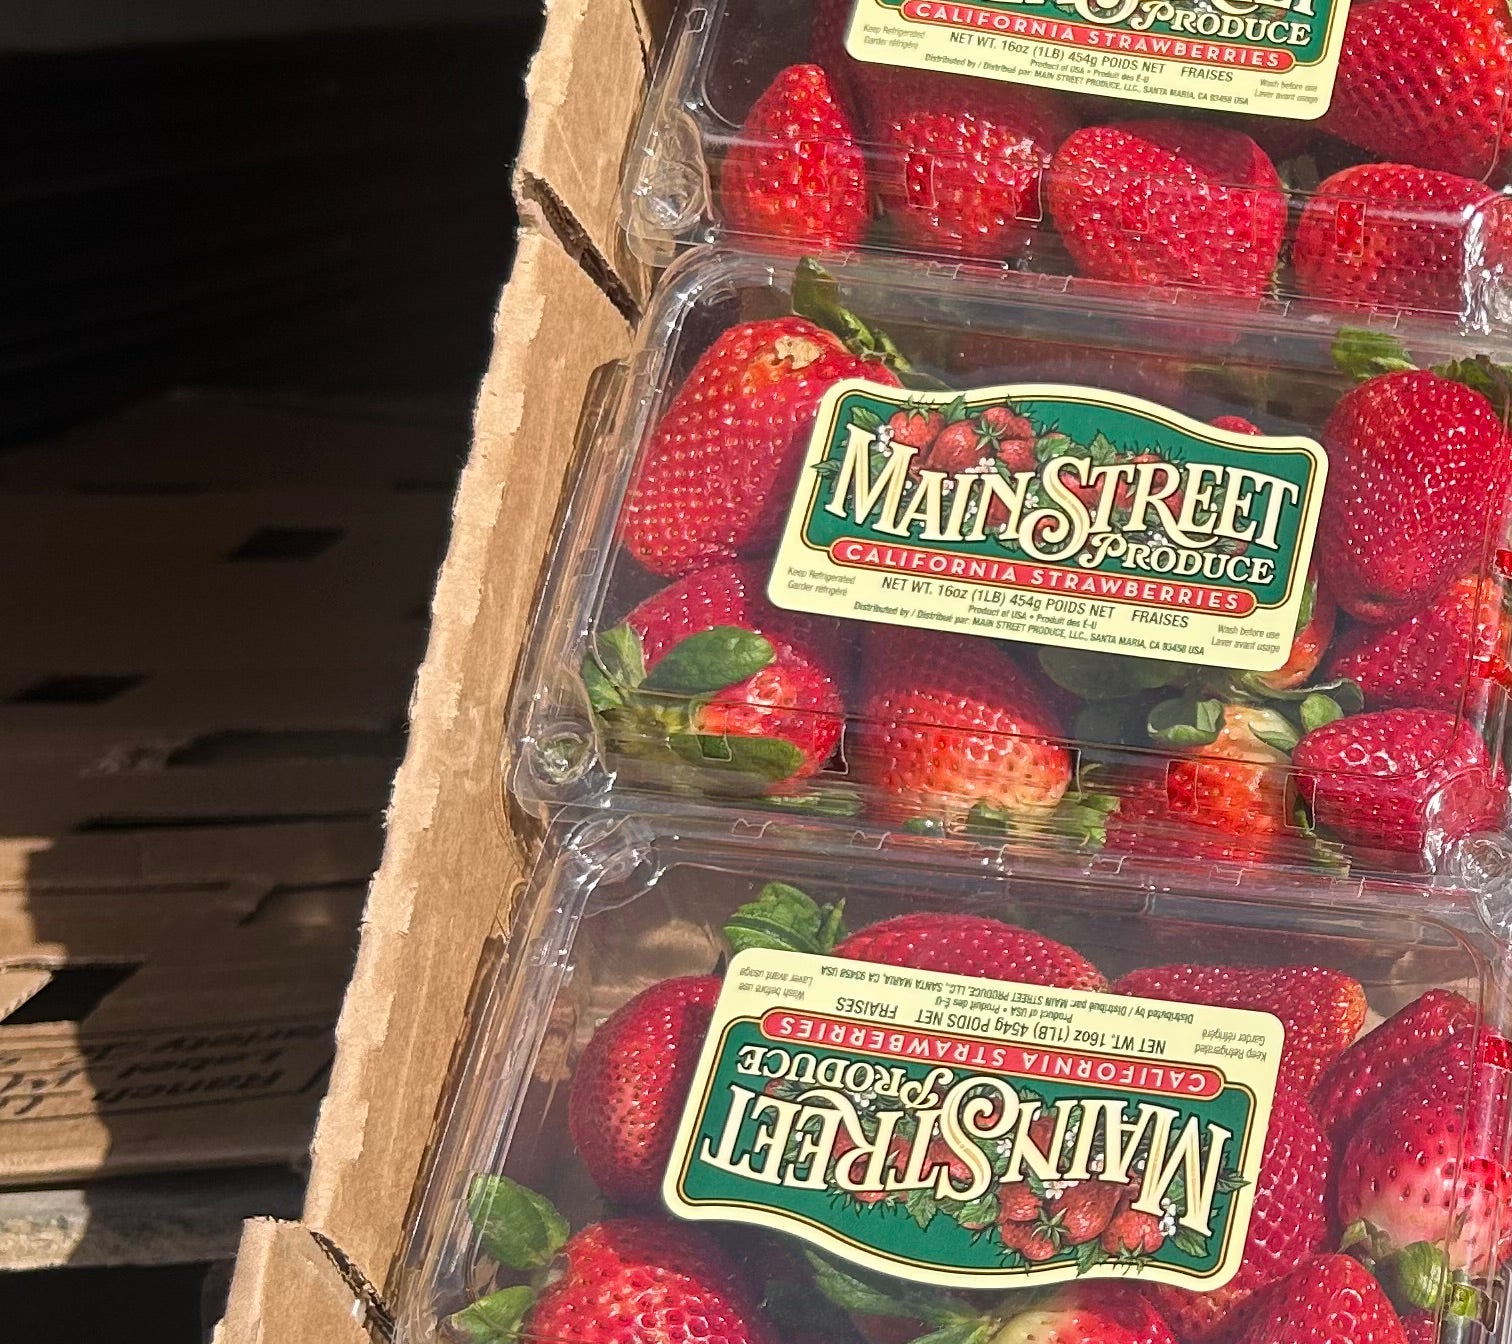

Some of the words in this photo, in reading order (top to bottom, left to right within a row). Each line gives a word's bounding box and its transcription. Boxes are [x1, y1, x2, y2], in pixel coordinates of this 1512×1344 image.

[914, 4, 1078, 39] CALIFORNIA
[1086, 28, 1280, 68] STRAWBERRIES
[1132, 1, 1314, 49] PRODUCE
[949, 32, 976, 45] NET
[1032, 44, 1067, 60] (1LB)
[1067, 49, 1099, 65] 454g
[1101, 54, 1140, 69] POIDS
[1141, 60, 1166, 73] NET
[1179, 65, 1235, 82] FRAISES
[843, 544, 1021, 582] CALIFORNIA
[1030, 568, 1239, 610] STRAWBERRIES
[1080, 533, 1277, 585] PRODUCE
[880, 576, 909, 591] NET
[909, 580, 936, 595] WT.
[935, 584, 970, 599] 16oz
[970, 588, 1008, 606] (1LB)
[1008, 593, 1043, 611] 454g
[1044, 598, 1087, 614] POIDS
[1088, 603, 1116, 618] NET
[1130, 609, 1190, 628] FRAISES
[834, 997, 900, 1019] FRAISES
[914, 1008, 945, 1025] NET
[945, 1012, 992, 1032] POIDS
[993, 1016, 1031, 1037] 454g
[777, 1018, 1007, 1066] STRAWBERRIES
[1030, 1021, 1071, 1043] (1LB)
[1071, 1029, 1108, 1047] 16oz
[1108, 1034, 1137, 1051] WT.
[1136, 1038, 1167, 1055] NET
[732, 1046, 951, 1107] PRODUCE
[1017, 1050, 1208, 1093] CALIFORNIA
